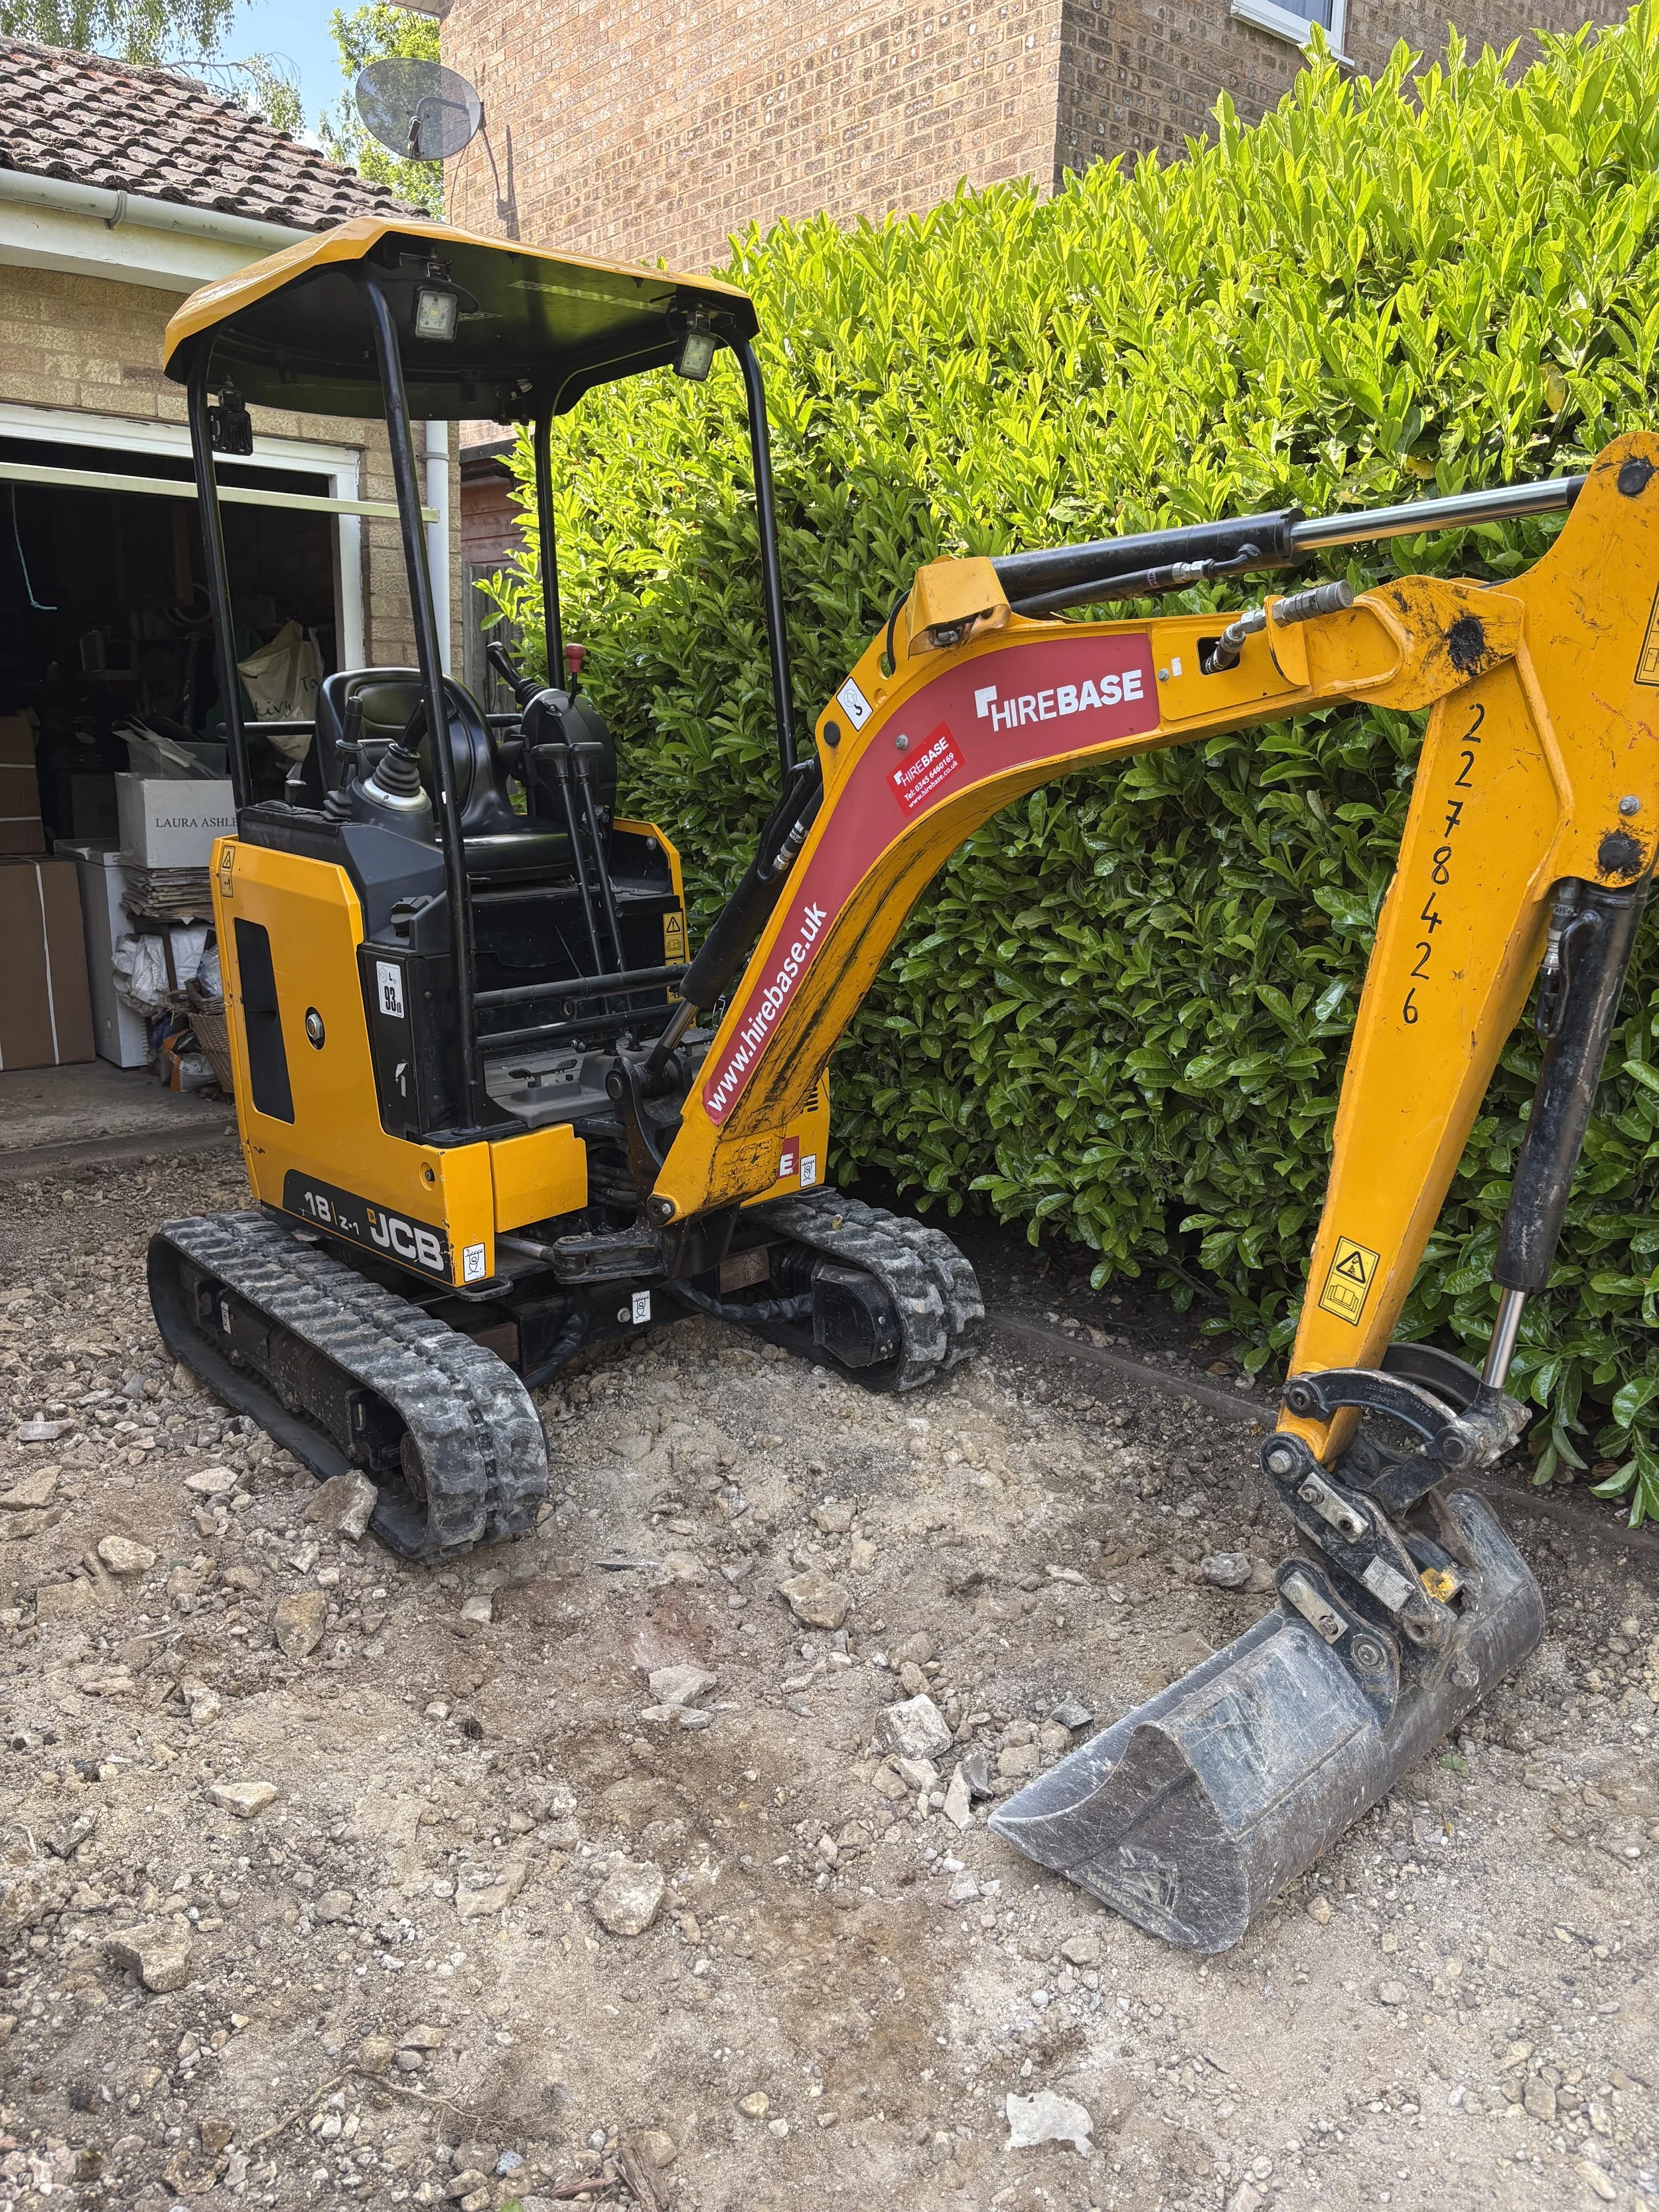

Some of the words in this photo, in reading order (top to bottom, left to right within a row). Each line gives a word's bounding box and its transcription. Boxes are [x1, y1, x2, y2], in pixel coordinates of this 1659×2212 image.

[991, 669, 1144, 731] HIREBASE
[901, 736, 949, 786] HIREBASE
[904, 788, 916, 801] Tel:
[914, 775, 930, 792] 0345
[929, 752, 954, 778] 6460169
[908, 760, 958, 808] www.hirebase.co.uk
[155, 818, 198, 828] LAURA
[201, 818, 238, 827] ASHLE
[1403, 703, 1484, 1024] 2278426
[384, 986, 396, 1011] 93
[707, 901, 828, 1112] www.hirebase.uk
[305, 1191, 332, 1222] 18
[370, 1213, 445, 1271] JCB
